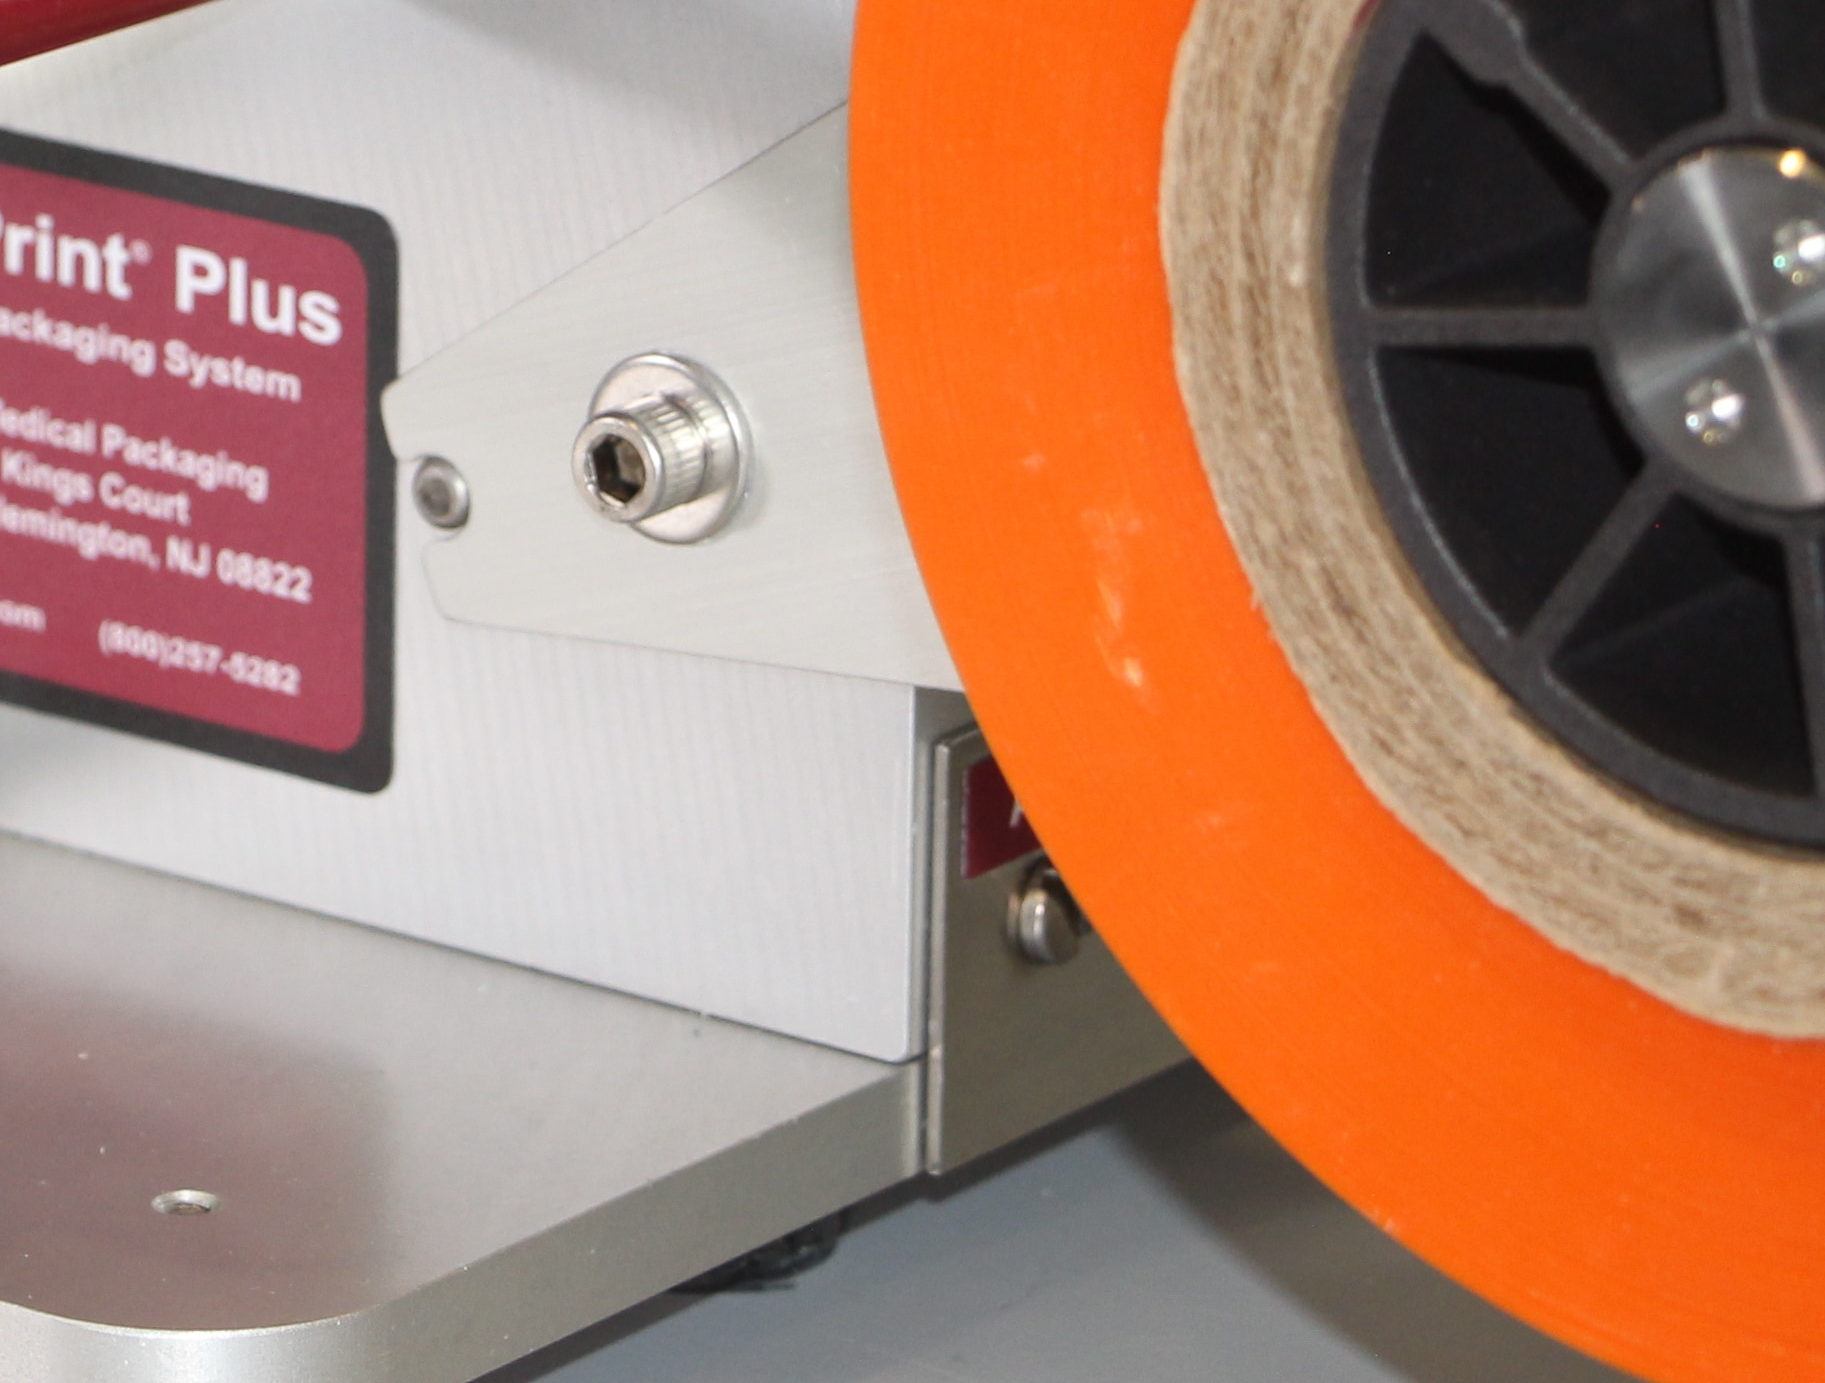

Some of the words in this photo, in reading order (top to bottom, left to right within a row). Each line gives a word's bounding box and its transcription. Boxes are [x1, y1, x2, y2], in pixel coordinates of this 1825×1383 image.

[175, 243, 342, 346] Plus
[163, 338, 302, 402] System
[0, 446, 95, 507] Kings
[98, 470, 192, 527] Court
[101, 422, 270, 505] Packaging
[164, 534, 213, 580] NJ
